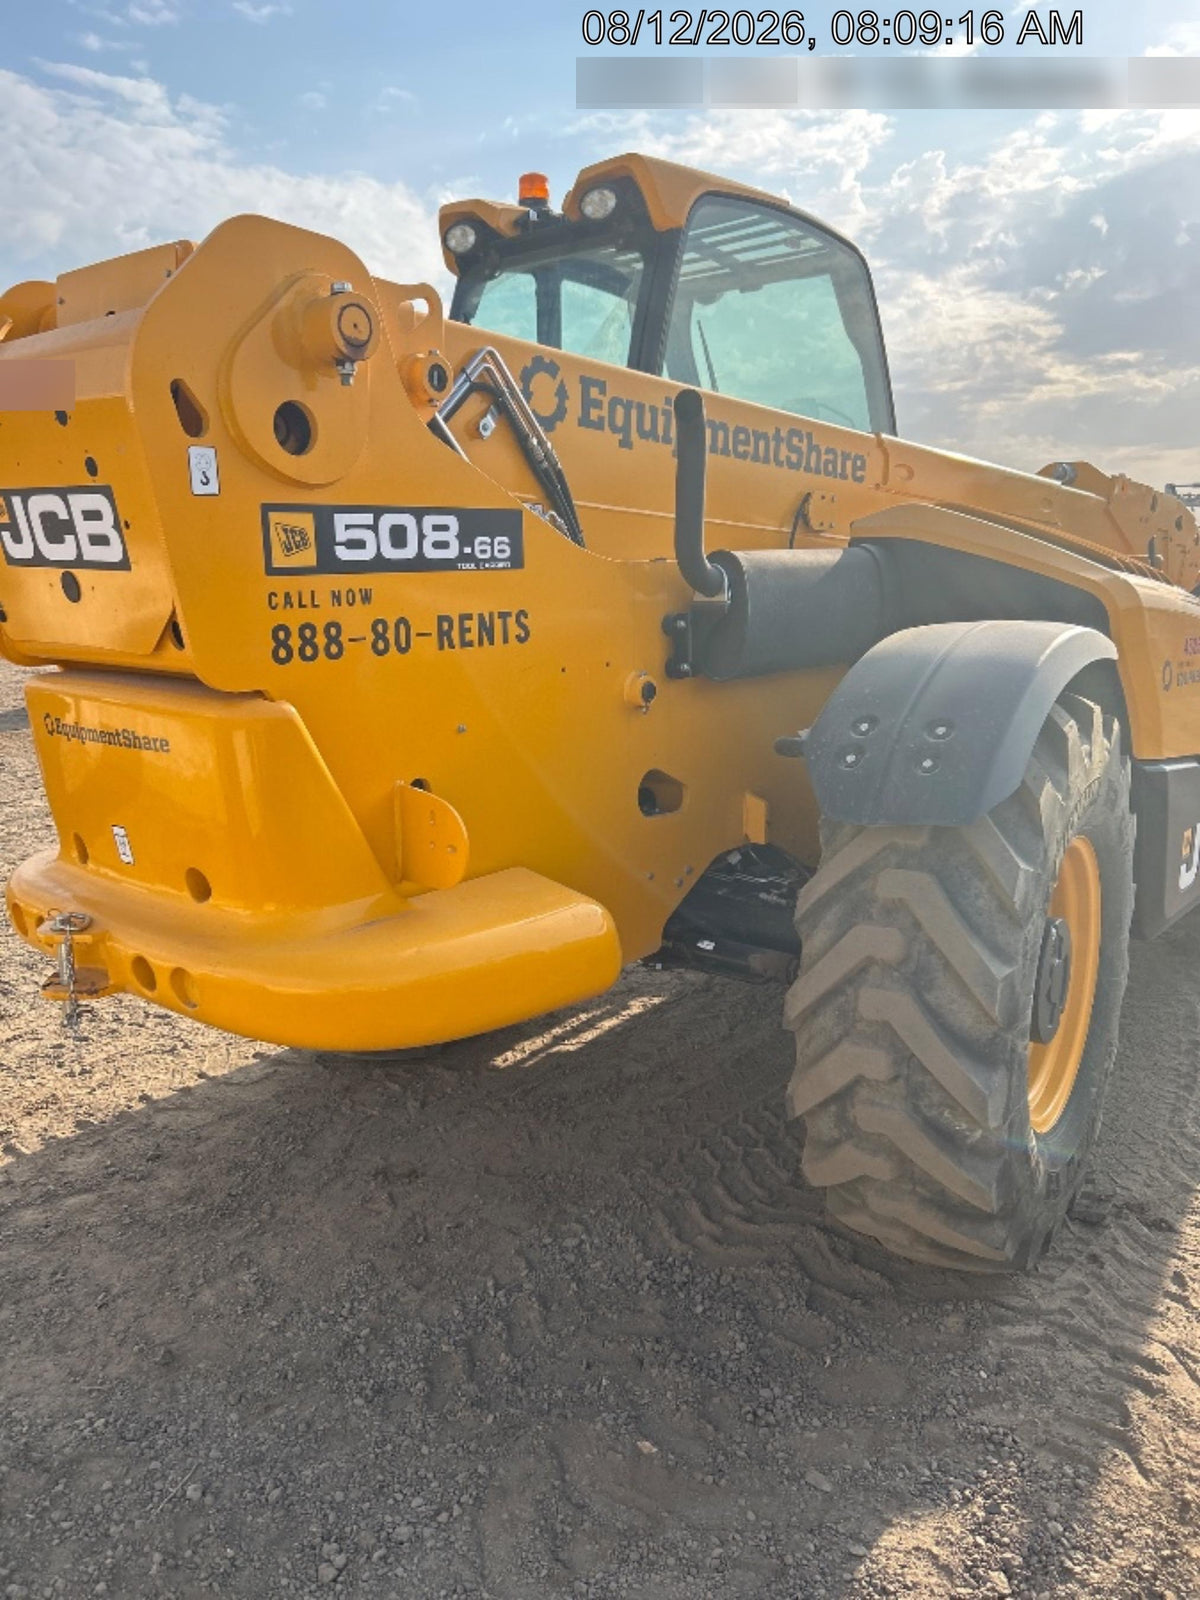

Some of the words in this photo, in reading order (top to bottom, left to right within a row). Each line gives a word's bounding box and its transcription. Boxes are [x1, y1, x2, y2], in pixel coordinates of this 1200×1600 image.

[577, 375, 867, 484] EquimentShare
[1, 493, 123, 562] JCB
[267, 590, 321, 611] CALL
[331, 588, 373, 607] NOW
[271, 609, 531, 666] 888-80-RENTS
[55, 717, 171, 753] EquipmentShare
